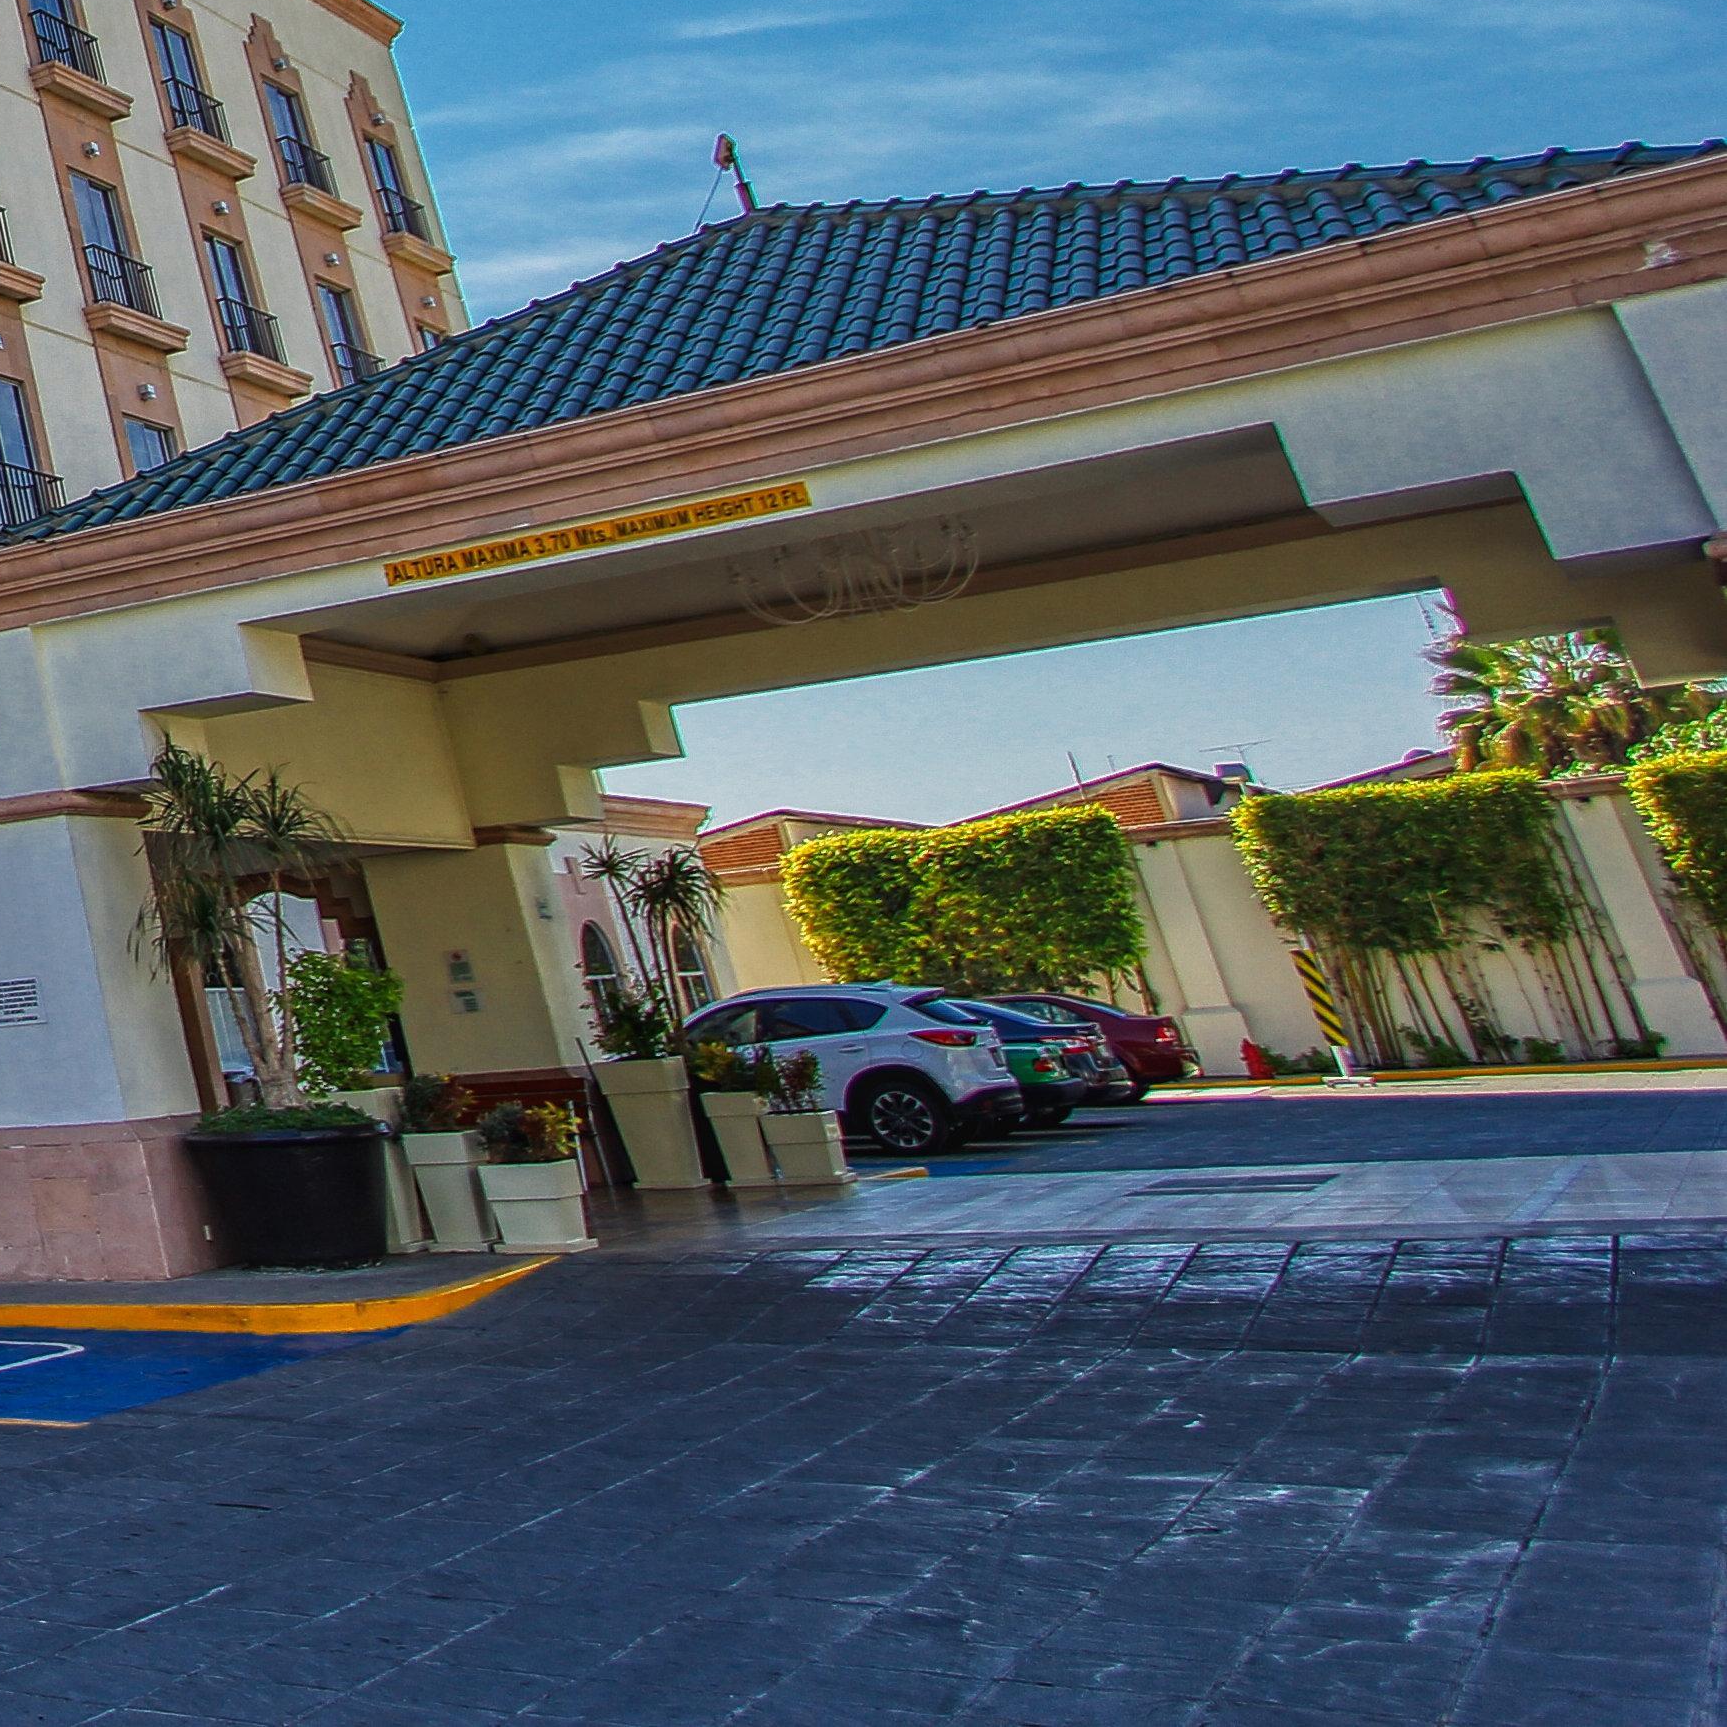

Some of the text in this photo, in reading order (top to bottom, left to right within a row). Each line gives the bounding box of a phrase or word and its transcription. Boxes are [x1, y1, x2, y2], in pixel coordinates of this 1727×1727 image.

[391, 555, 459, 581] ALTURA
[533, 533, 571, 554] 3.70
[616, 509, 690, 536] MAXIMUM
[695, 497, 754, 521] HEIGHT
[758, 492, 779, 509] 12
